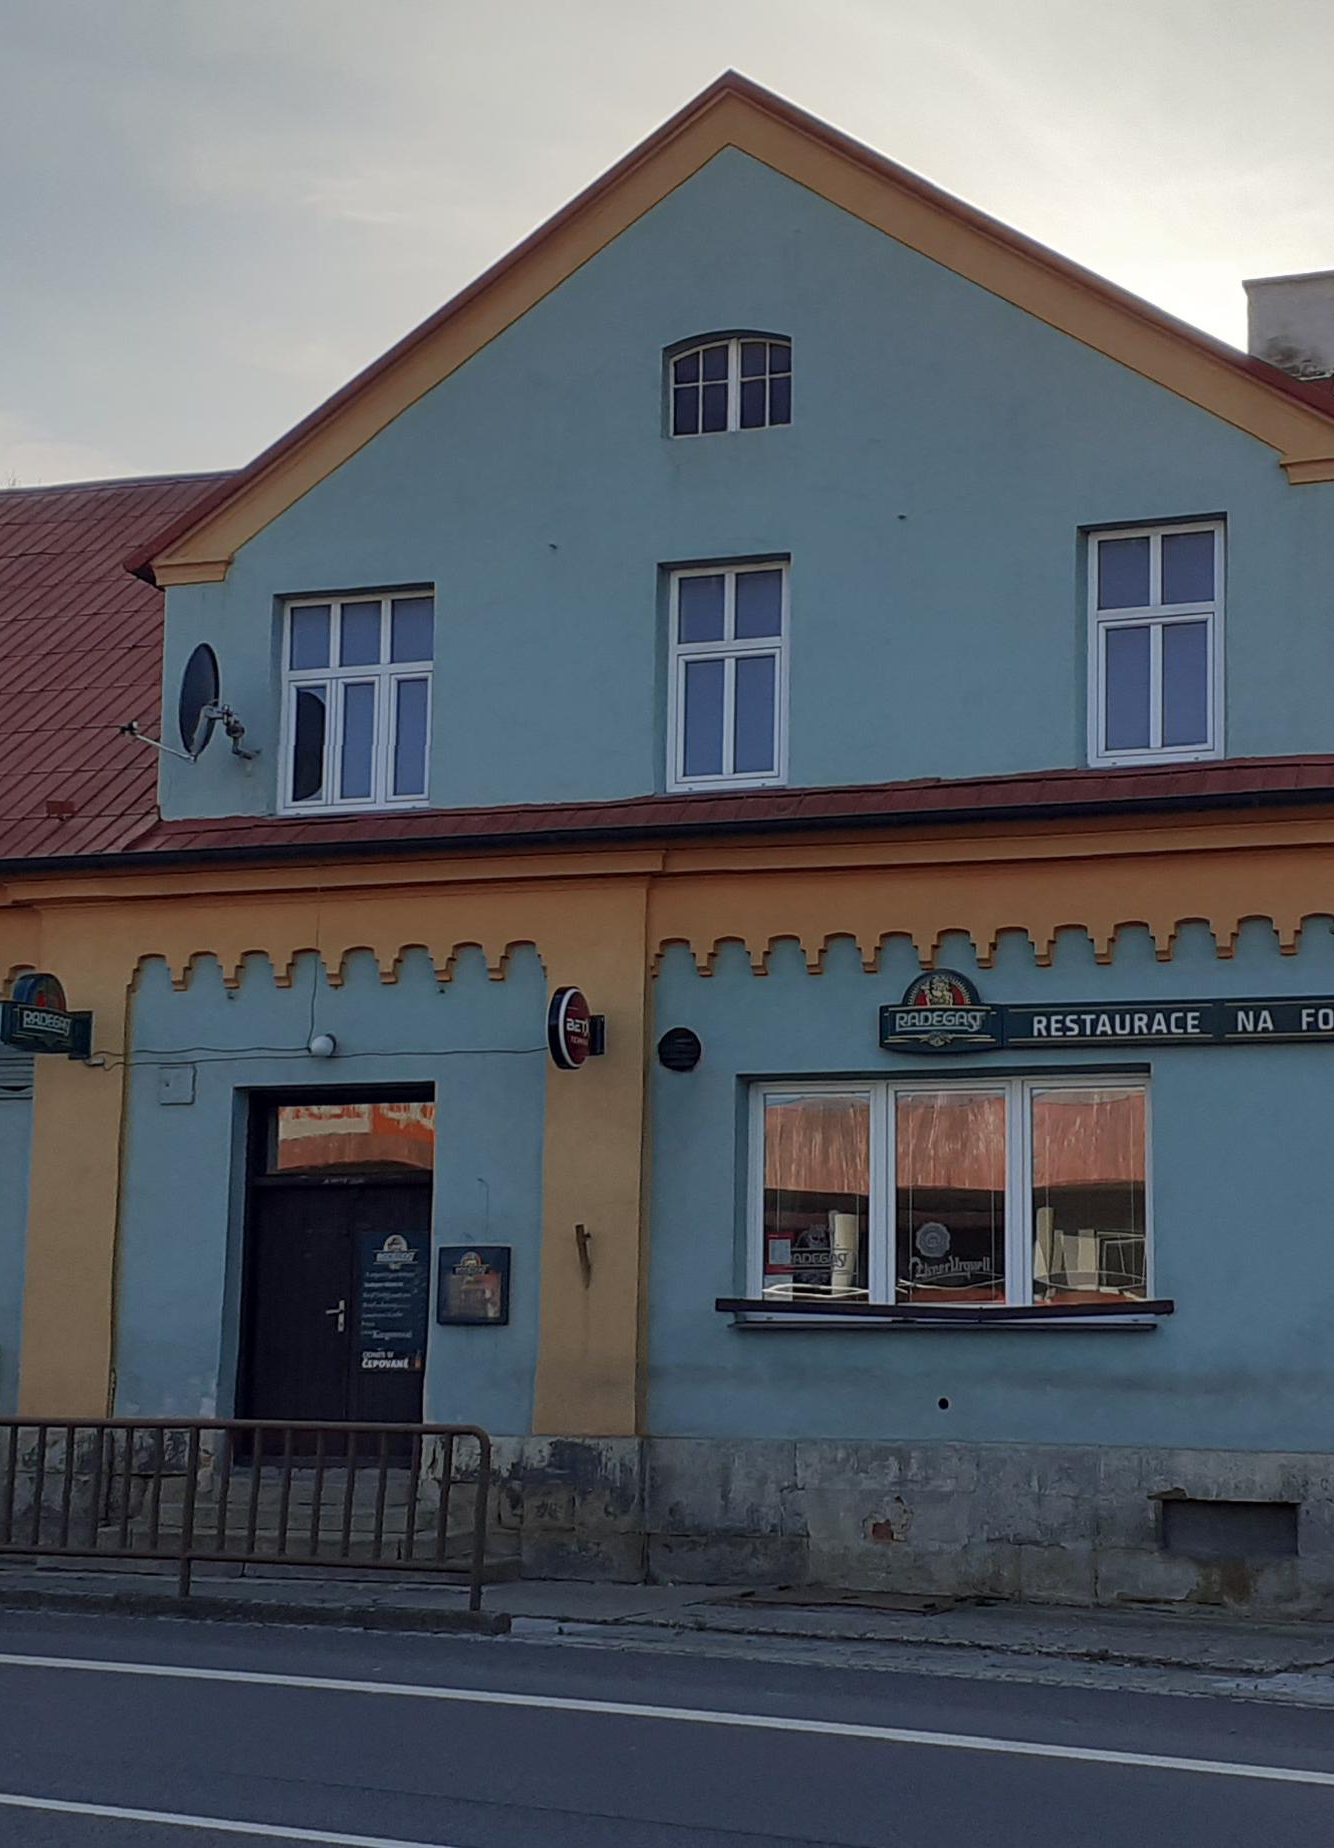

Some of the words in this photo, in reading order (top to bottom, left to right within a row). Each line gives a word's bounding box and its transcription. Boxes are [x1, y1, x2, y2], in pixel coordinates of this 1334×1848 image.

[895, 1011, 986, 1032] RADEGAST
[1032, 1011, 1201, 1037] RESTAURACE
[1237, 1010, 1275, 1032] NA
[789, 1252, 848, 1269] ADEGAST
